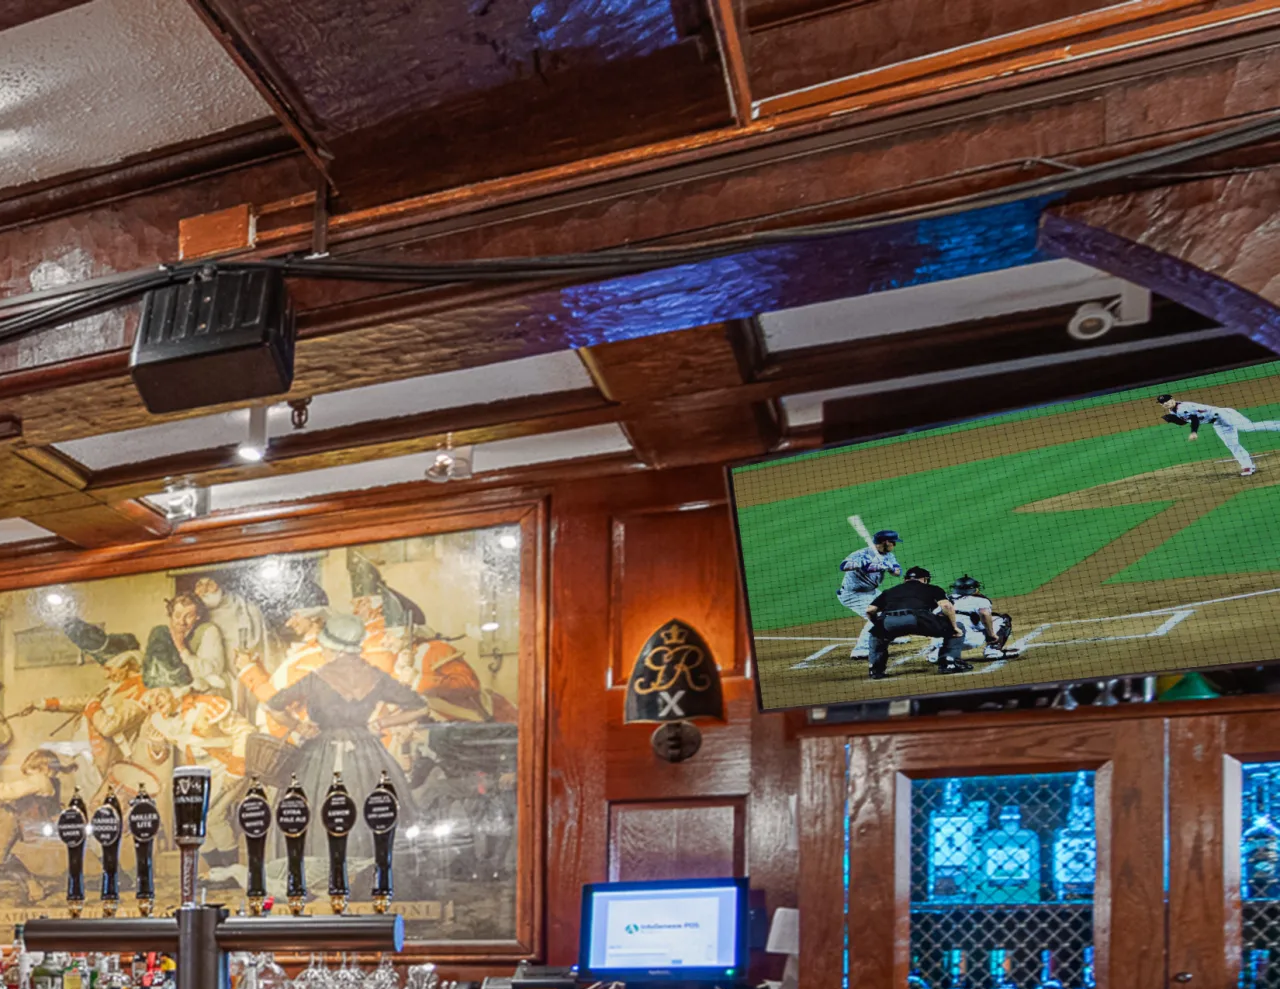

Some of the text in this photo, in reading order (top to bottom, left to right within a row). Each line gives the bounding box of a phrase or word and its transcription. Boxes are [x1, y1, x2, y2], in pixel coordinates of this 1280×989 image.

[658, 690, 686, 717] X
[131, 813, 158, 821] MILLER
[136, 821, 152, 829] LITE
